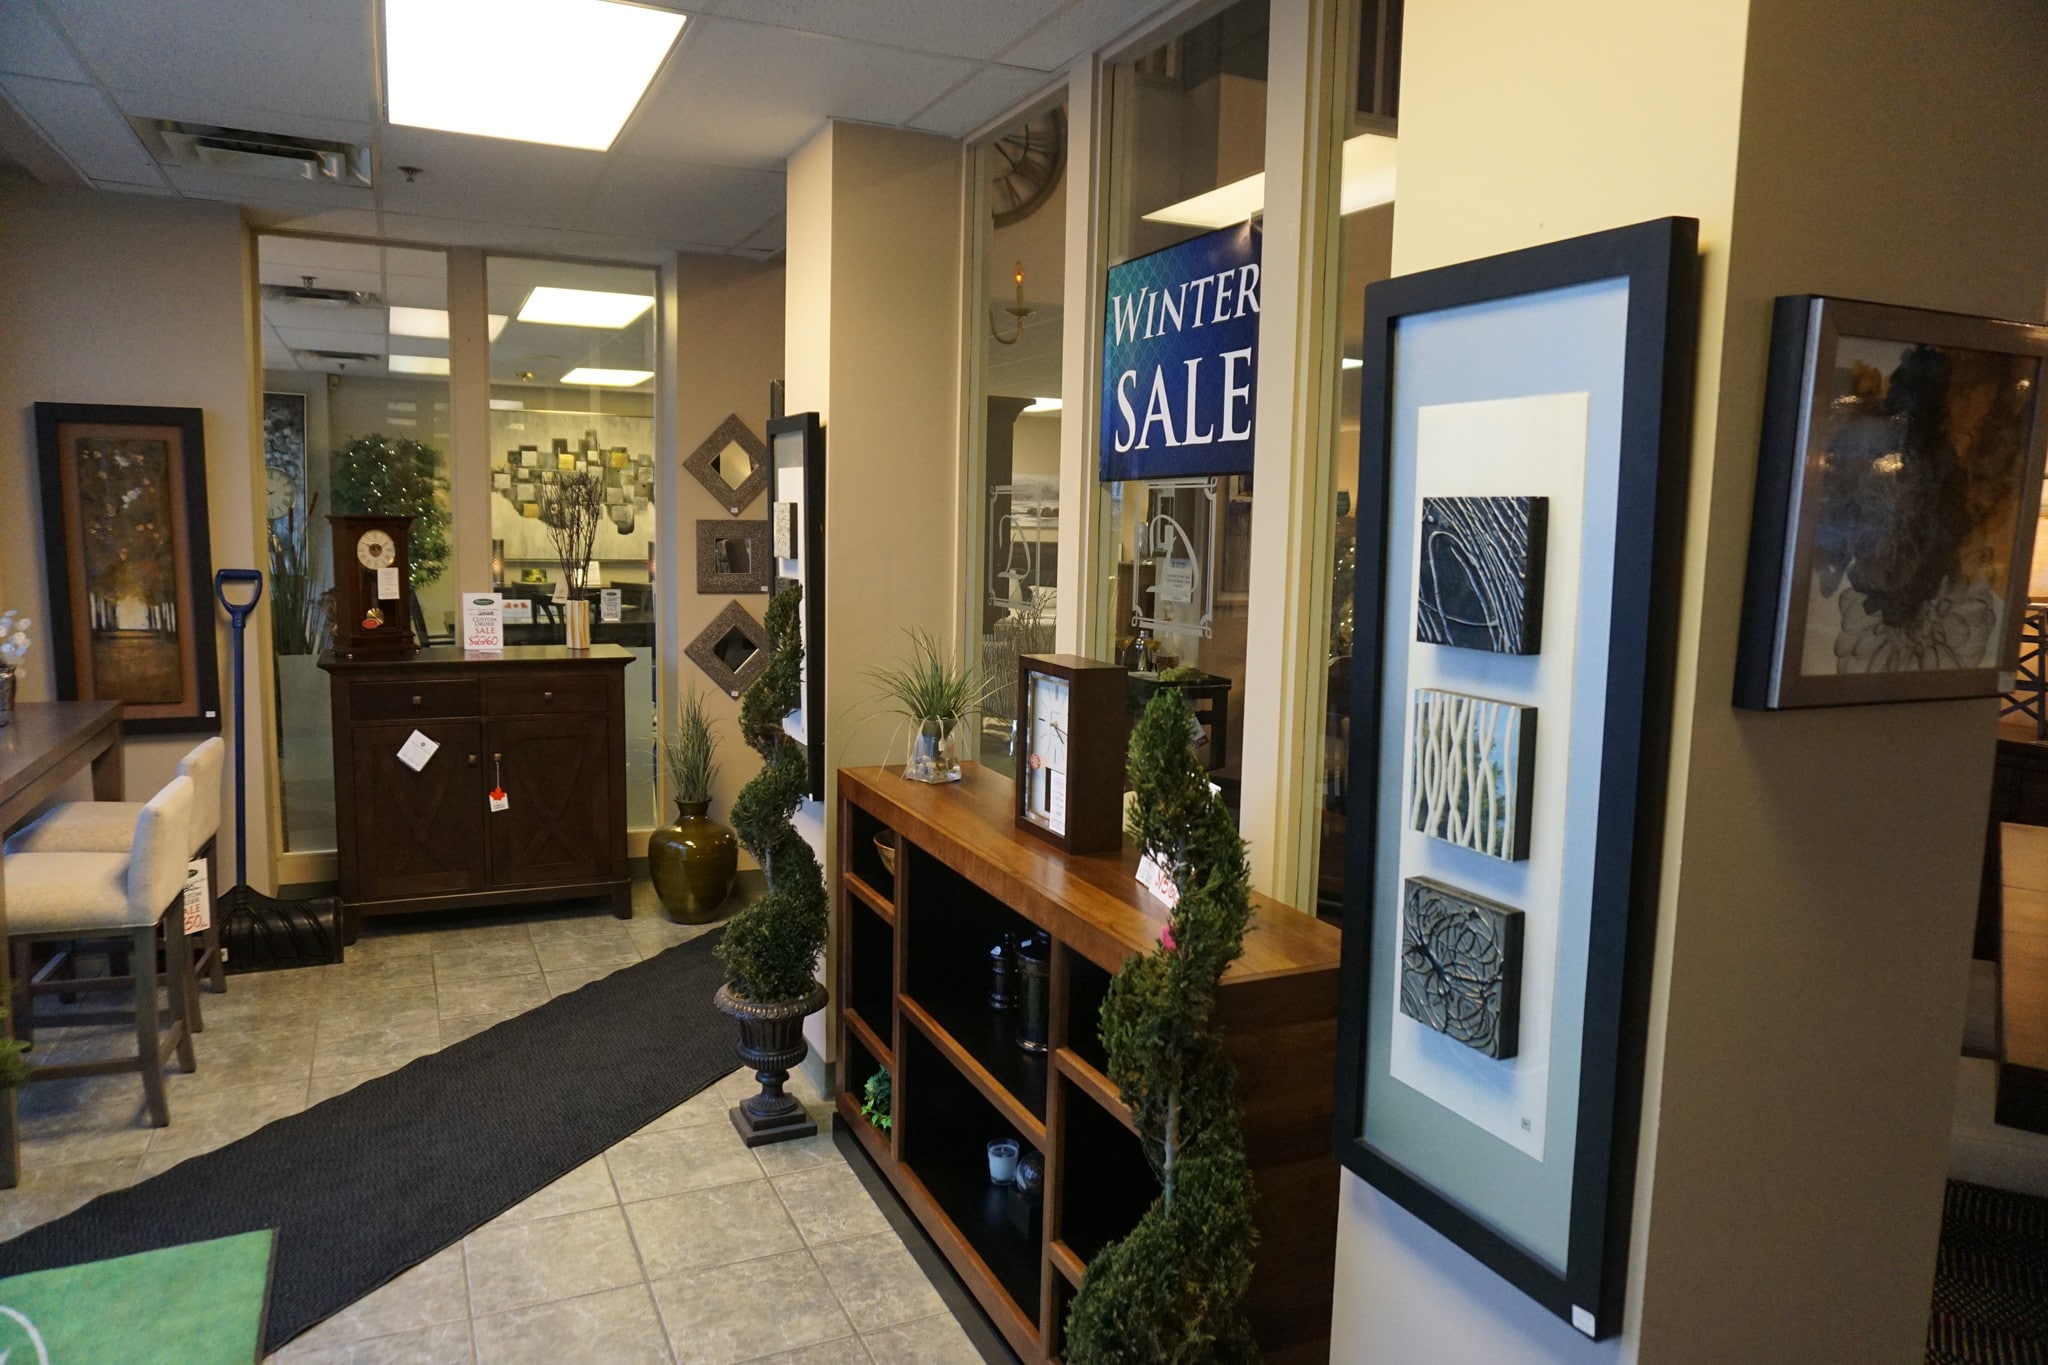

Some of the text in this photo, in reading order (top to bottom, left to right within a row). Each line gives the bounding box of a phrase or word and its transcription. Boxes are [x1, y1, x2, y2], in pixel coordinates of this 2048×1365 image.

[1112, 263, 1260, 347] WINTER
[1115, 347, 1252, 453] SALE
[475, 626, 496, 634] SALE
